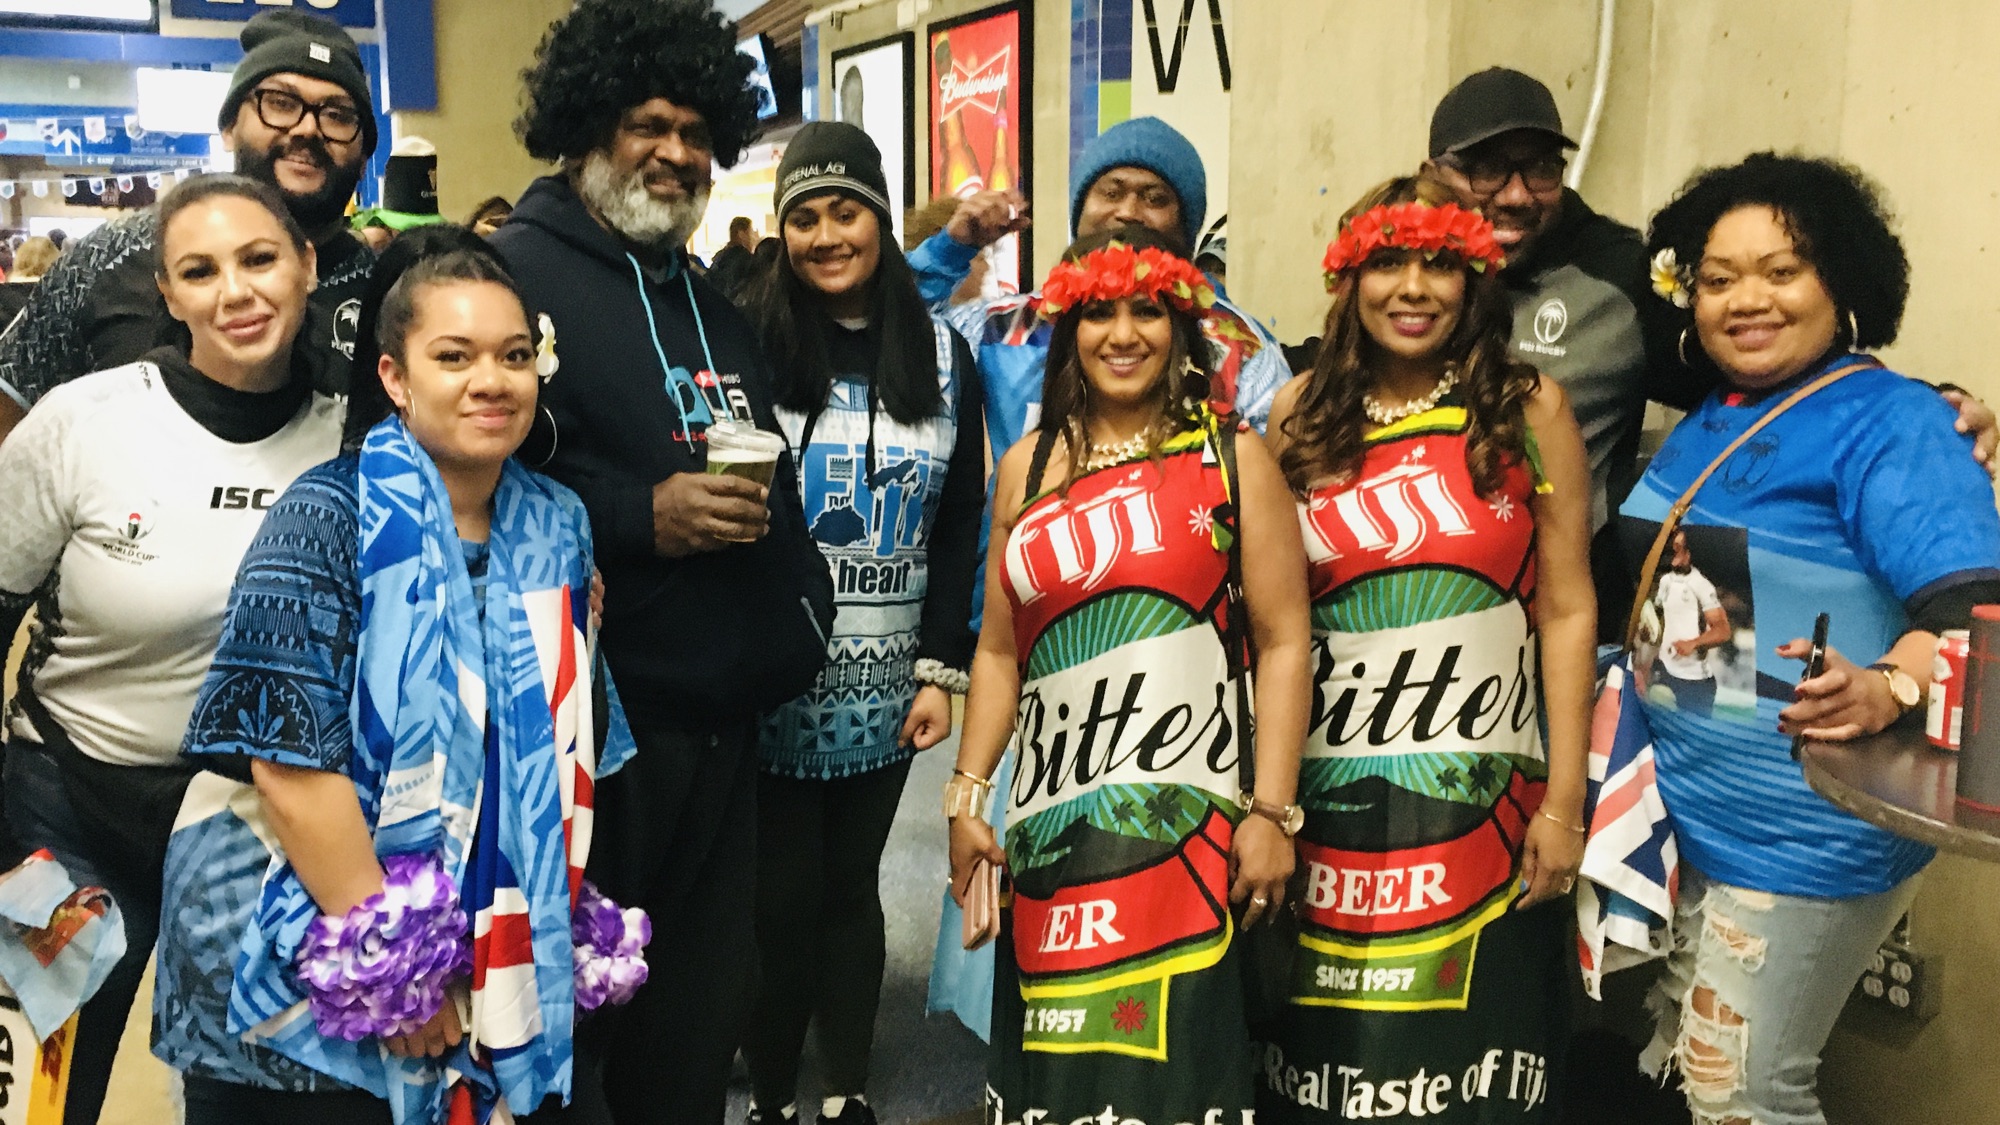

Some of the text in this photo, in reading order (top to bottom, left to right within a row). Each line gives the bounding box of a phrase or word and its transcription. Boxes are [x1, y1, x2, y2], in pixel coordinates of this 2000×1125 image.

[940, 66, 1009, 104] Budweiser
[210, 487, 275, 510] ISC
[102, 543, 135, 557] WORLD
[136, 552, 155, 561] CUP
[1010, 672, 1240, 808] Bitter
[1304, 861, 1453, 917] BEER
[1316, 965, 1417, 992] SINCE 1957
[1037, 1007, 1088, 1033] 1957
[1264, 1043, 1330, 1111] Real
[1337, 1066, 1452, 1120] Taste
[1461, 1049, 1504, 1104] of
